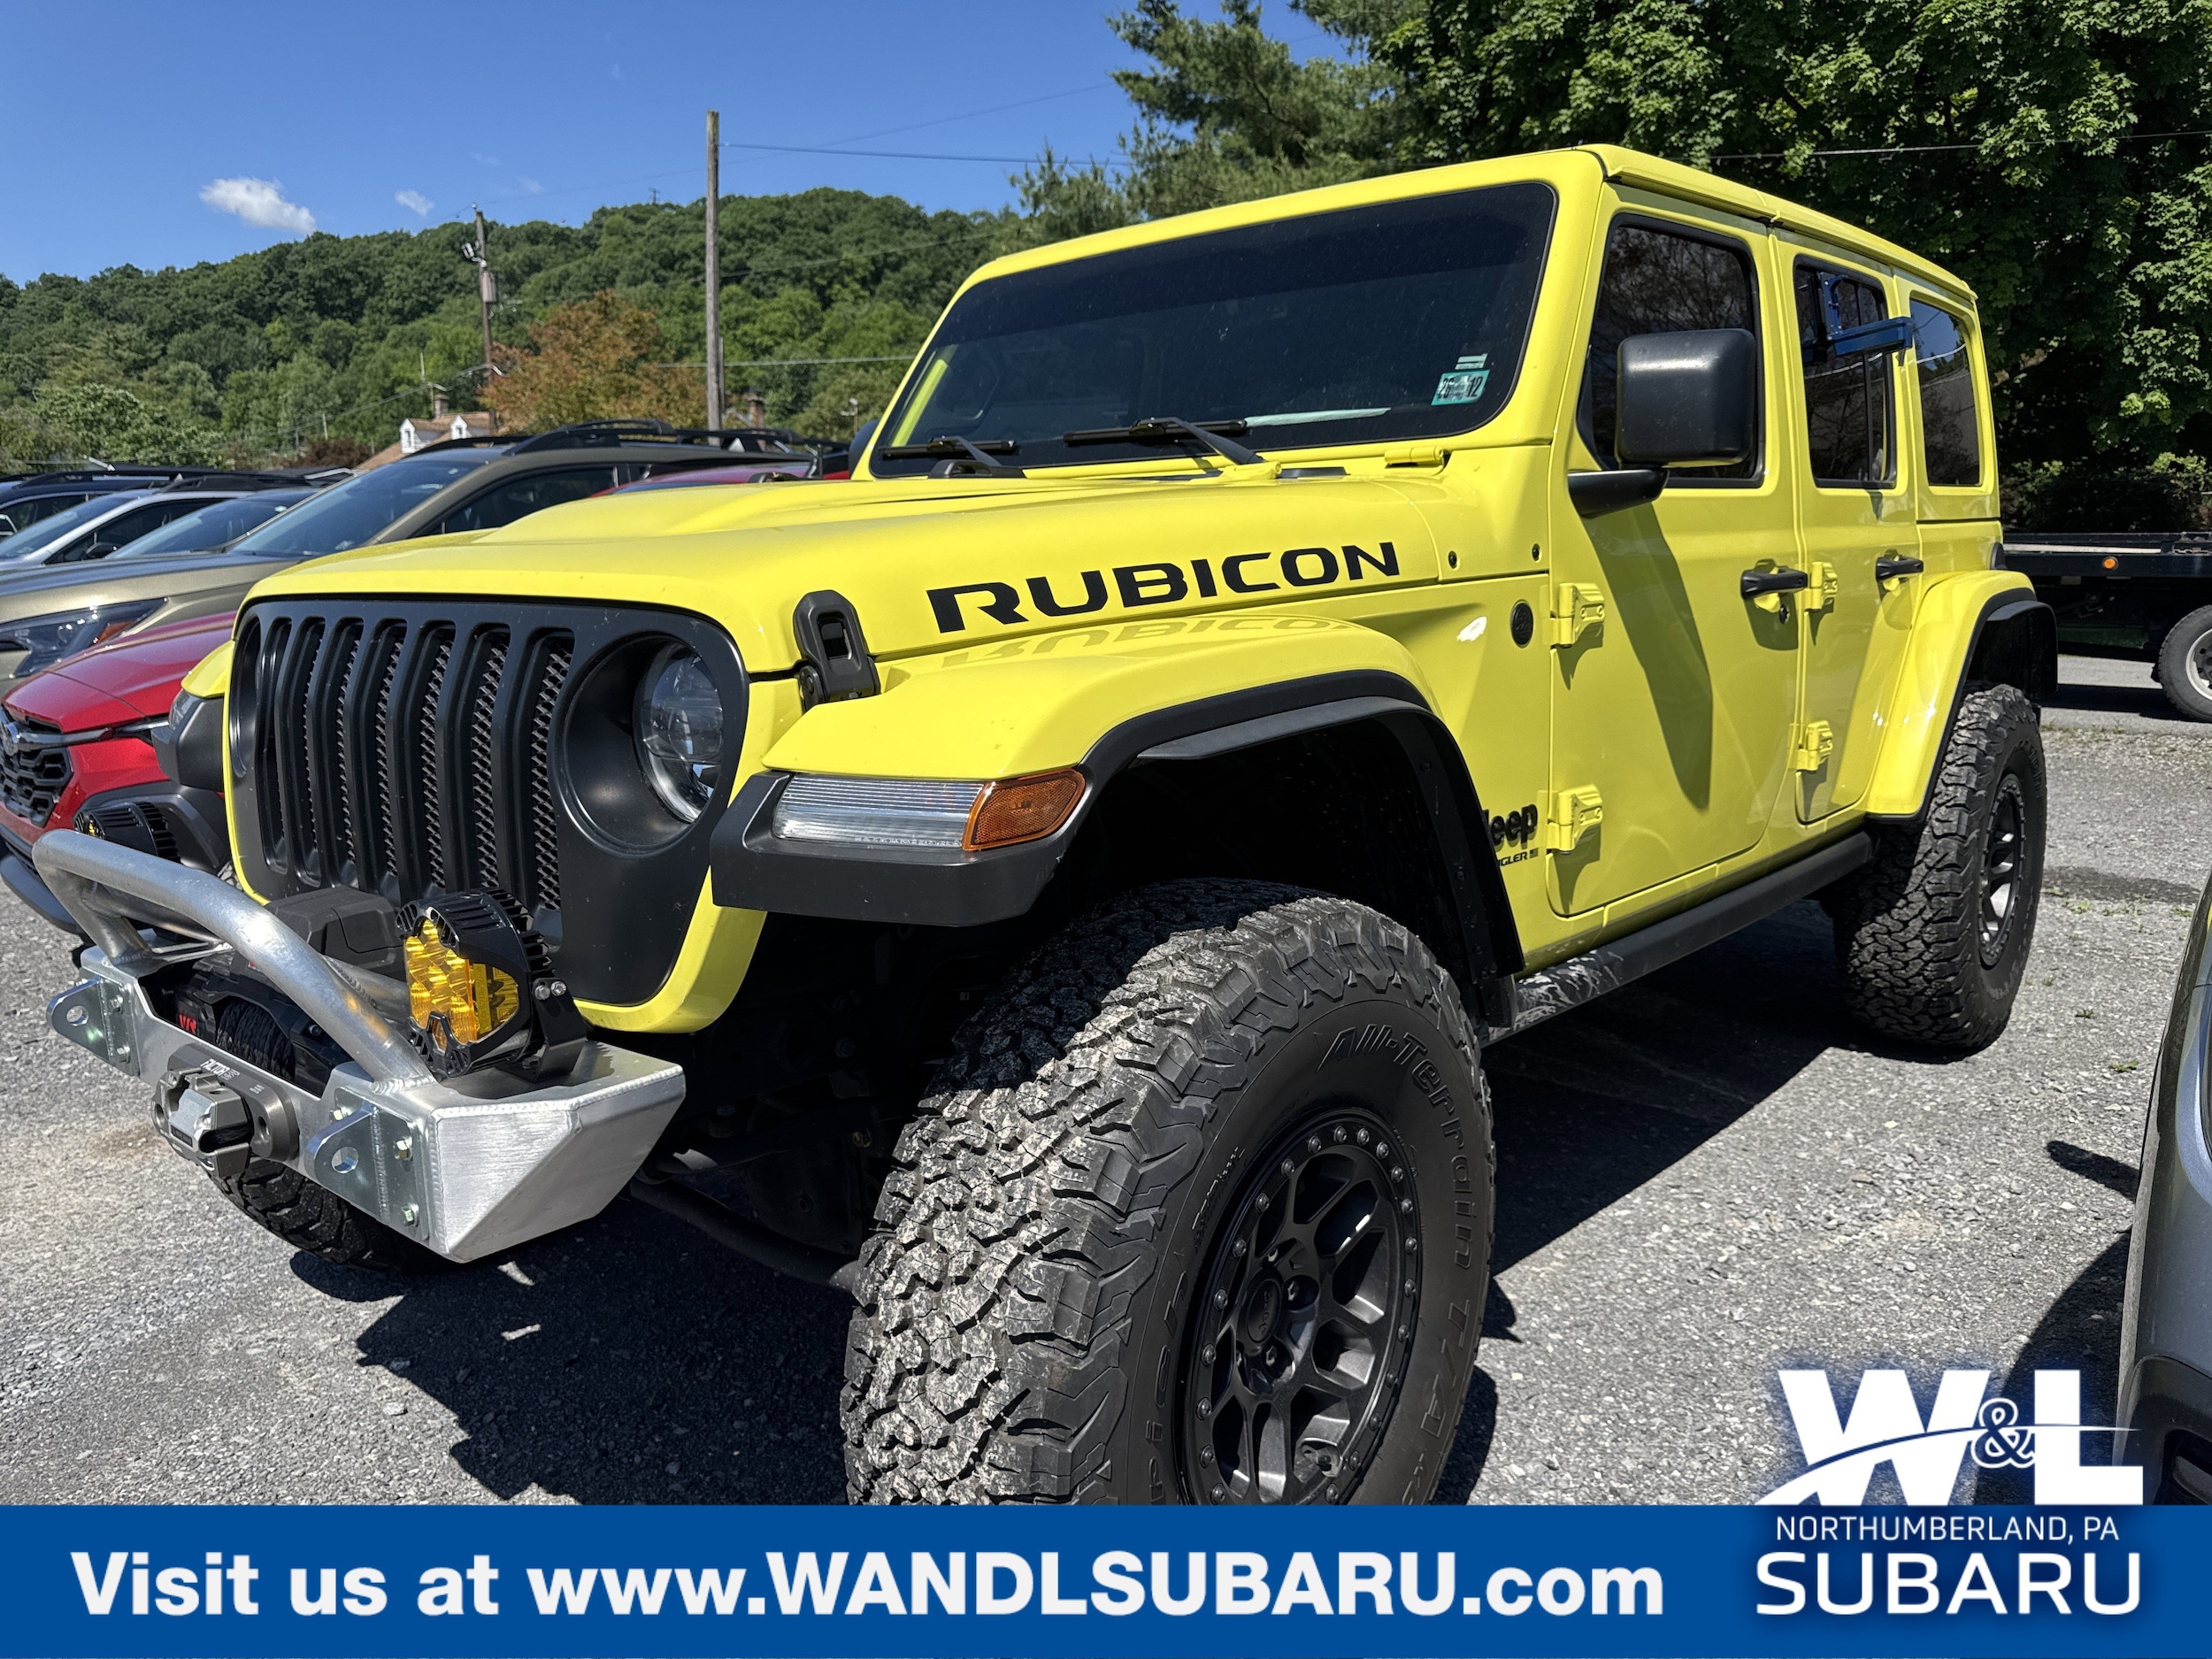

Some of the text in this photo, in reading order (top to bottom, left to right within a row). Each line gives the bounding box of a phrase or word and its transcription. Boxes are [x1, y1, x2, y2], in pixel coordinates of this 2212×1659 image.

[1466, 376, 1484, 398] 12
[926, 541, 1401, 634] RUBICON
[1497, 851, 1528, 867] GLER
[1316, 1023, 1474, 1270] All-Terrain
[1421, 1299, 1471, 1440] T/A
